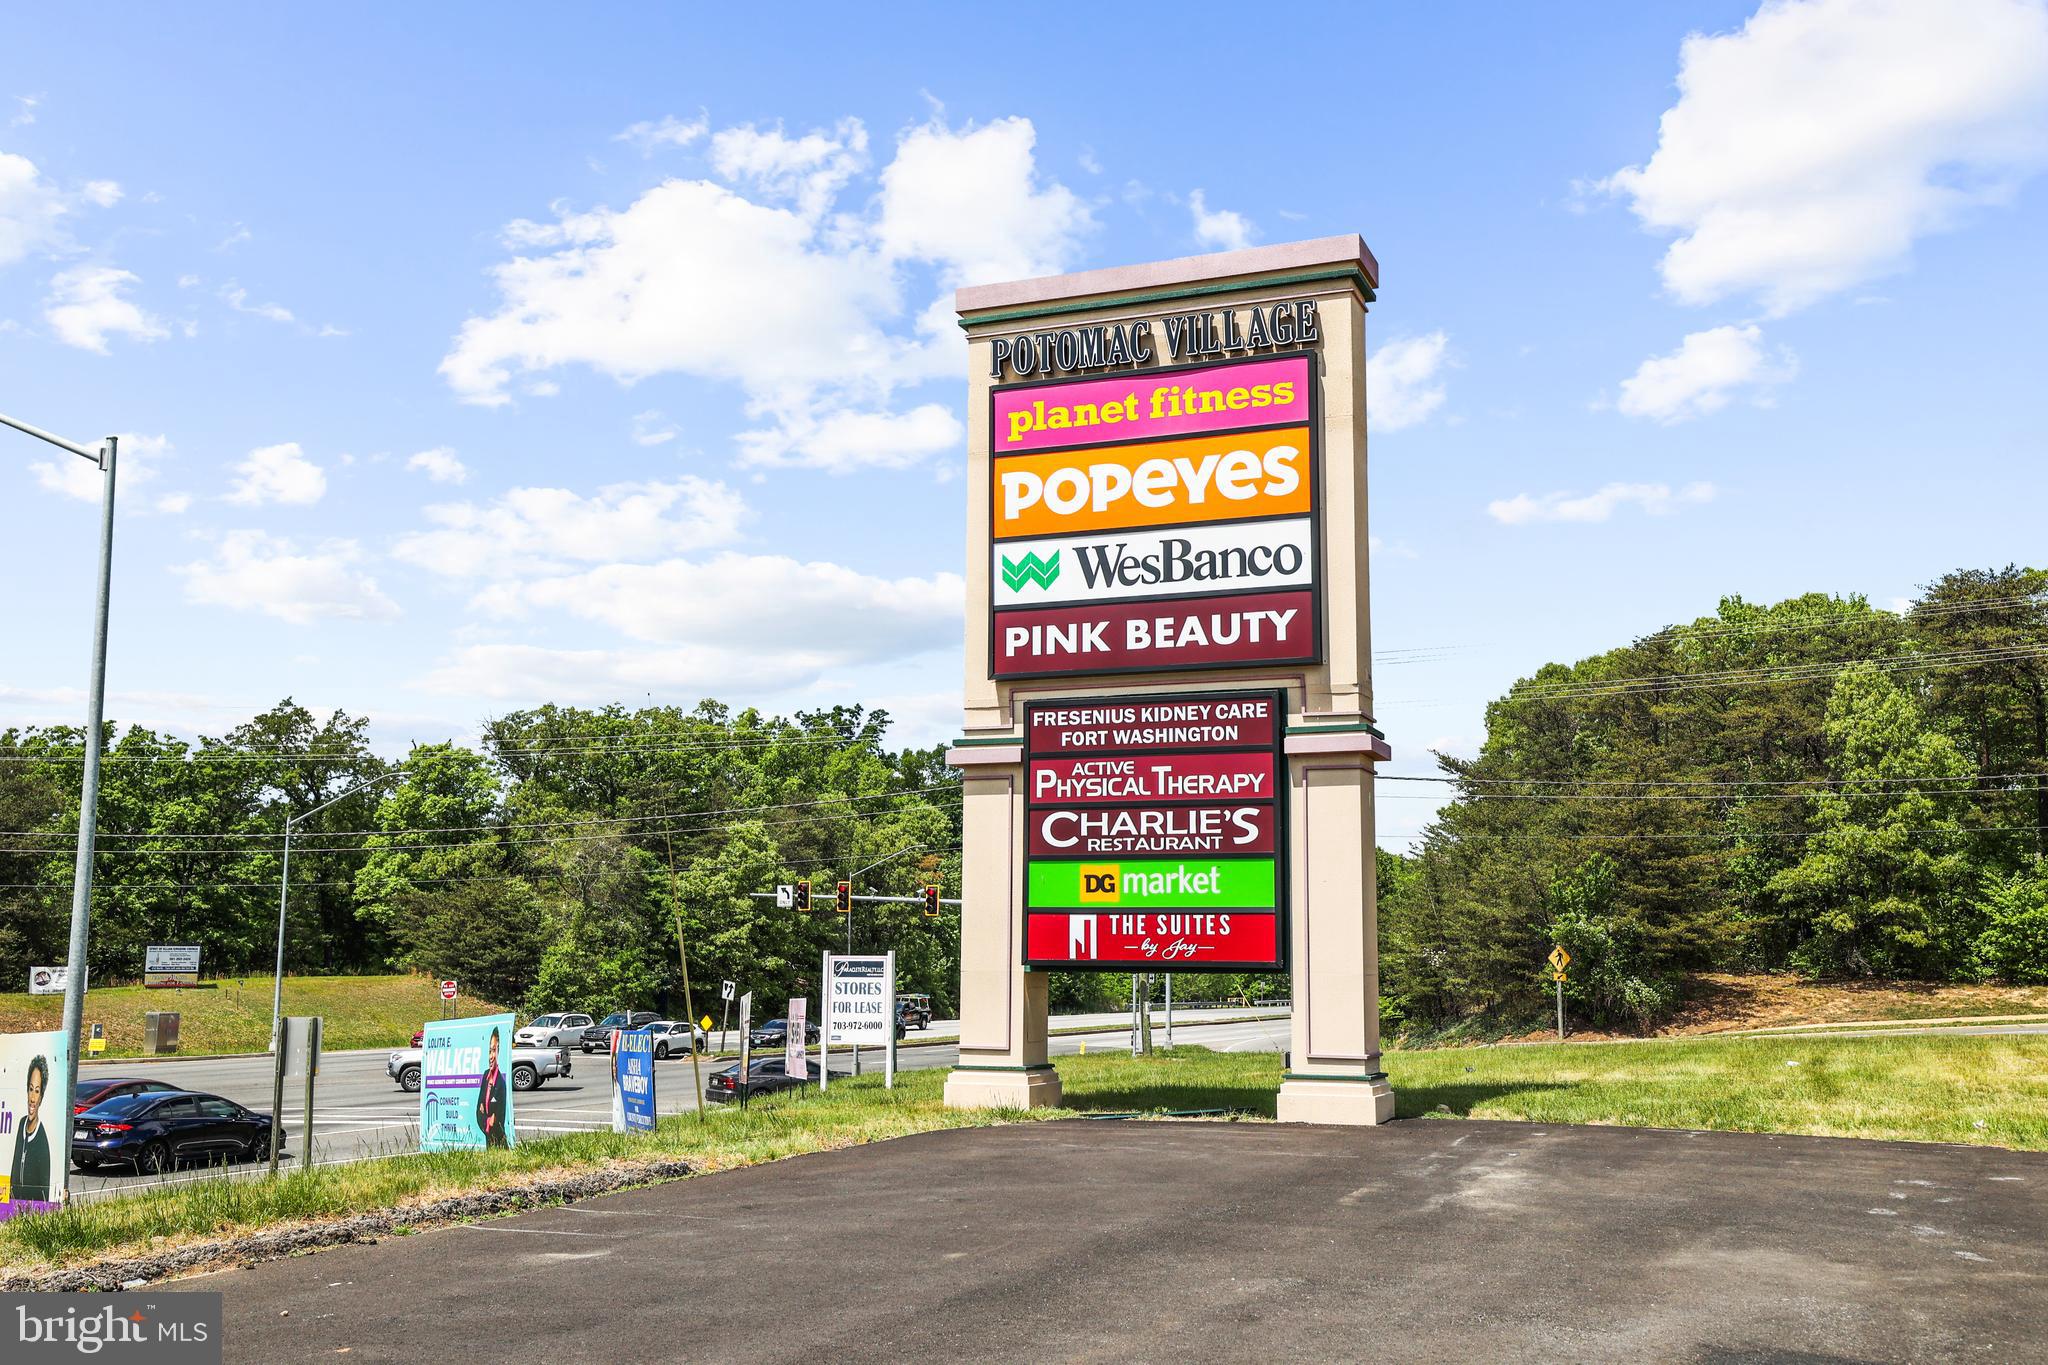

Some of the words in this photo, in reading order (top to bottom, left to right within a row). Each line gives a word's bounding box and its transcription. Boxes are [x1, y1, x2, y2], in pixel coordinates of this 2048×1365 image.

[989, 319, 1151, 378] POTOMAC
[1161, 299, 1318, 359] VILLAGE
[1007, 391, 1139, 442] planet
[1150, 381, 1295, 420] fitness
[1072, 538, 1302, 590] WesBanco
[1005, 620, 1111, 657] PINK
[1126, 608, 1298, 650] BEAUTY
[1033, 707, 1136, 727] FRESENIUS
[1141, 704, 1212, 723] KIDNEY
[1215, 702, 1268, 720] CARE
[1061, 730, 1108, 747] FORT
[1112, 725, 1239, 745] WASHINGTON
[1071, 760, 1135, 776] ACTIVE
[1036, 769, 1151, 798] PHYSICAL
[1151, 765, 1265, 795] THERAPY
[1041, 807, 1260, 848] CHARLIE'S
[1087, 836, 1224, 852] RESTAURANT
[1084, 873, 1116, 893] DG
[1123, 864, 1221, 897] market
[1109, 914, 1146, 935] THE
[1156, 914, 1231, 936] SUITES
[1140, 937, 1159, 957] by
[1161, 937, 1199, 960] Jay
[834, 982, 882, 995] STORES
[833, 1001, 851, 1014] FOR
[854, 1001, 883, 1014] LEASE
[832, 1021, 883, 1030] 703-972-6000
[427, 1038, 446, 1049] LOLITA
[426, 1046, 481, 1076] WALKER
[440, 1096, 460, 1106] CONNECT
[445, 1110, 459, 1119] BUILD
